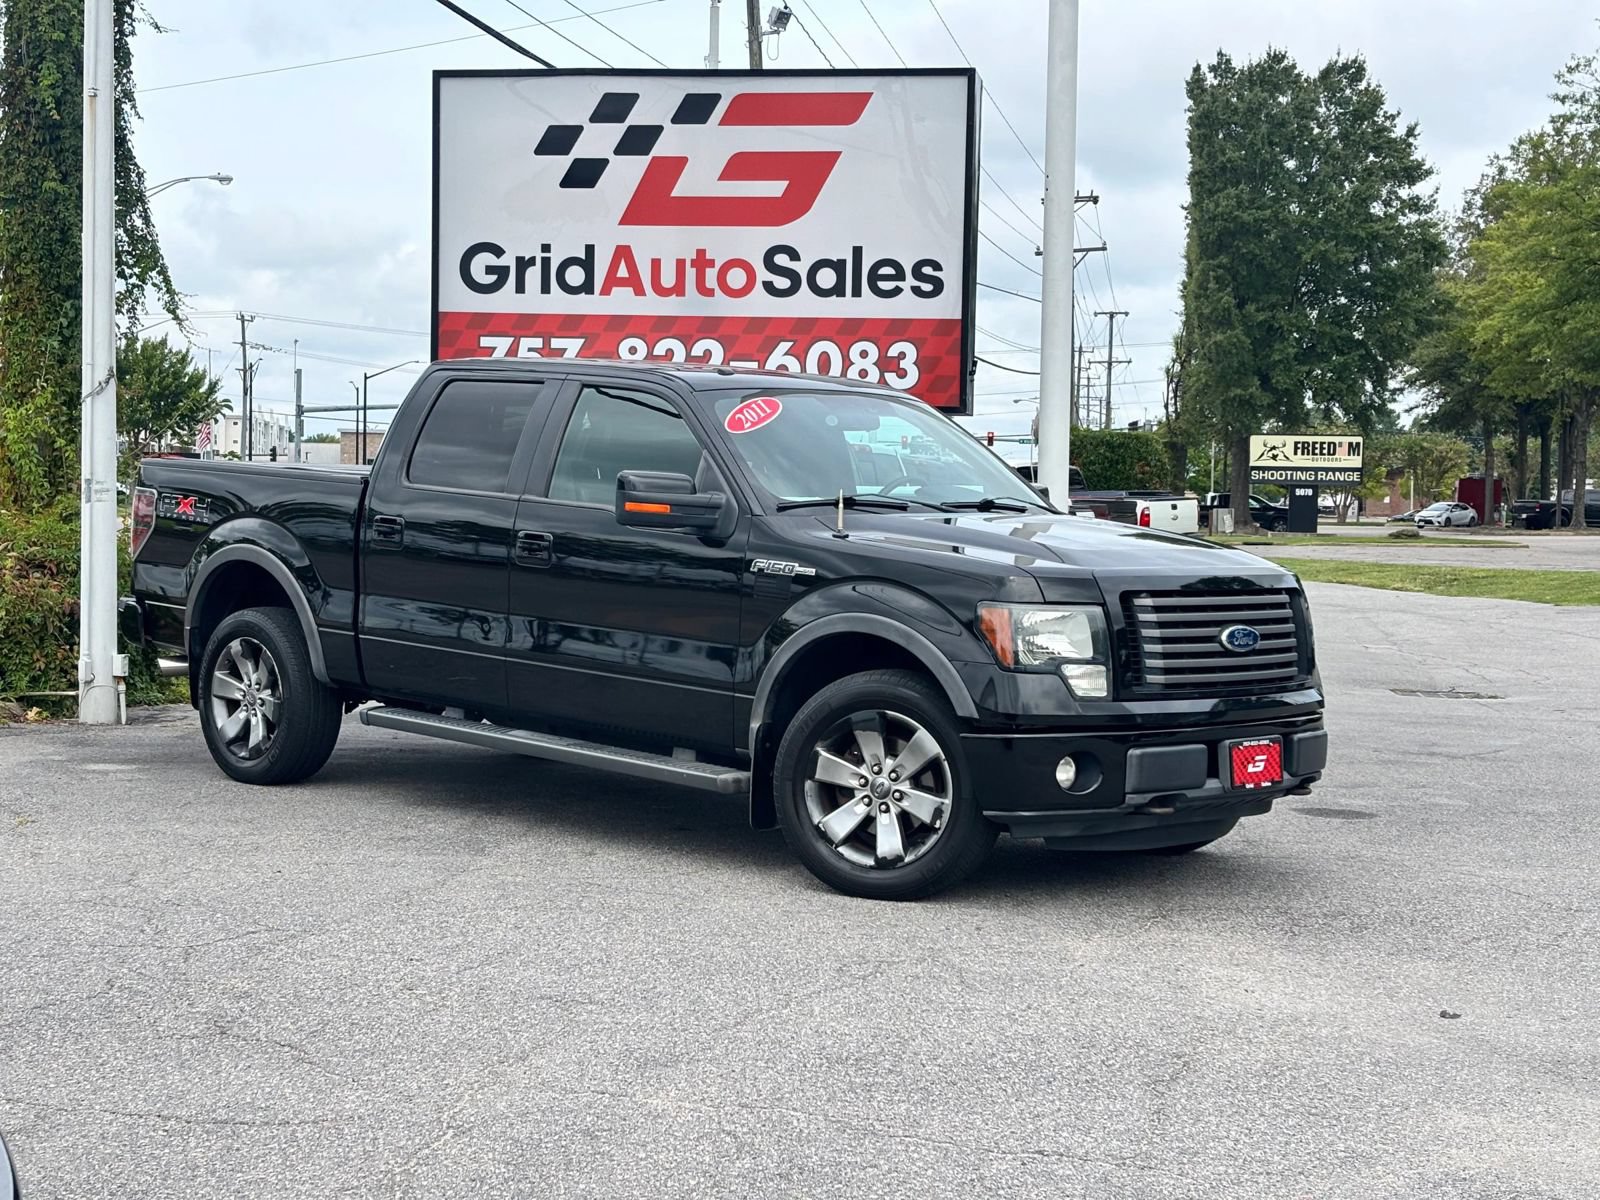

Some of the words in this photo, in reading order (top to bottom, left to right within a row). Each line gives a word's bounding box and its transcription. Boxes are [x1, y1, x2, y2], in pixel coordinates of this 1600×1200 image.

[459, 241, 945, 299] GridAutoSales
[734, 399, 772, 429] 2011
[1251, 470, 1315, 481] SHOOTING
[1317, 471, 1361, 482] RANGE
[1233, 630, 1254, 645] Ford
